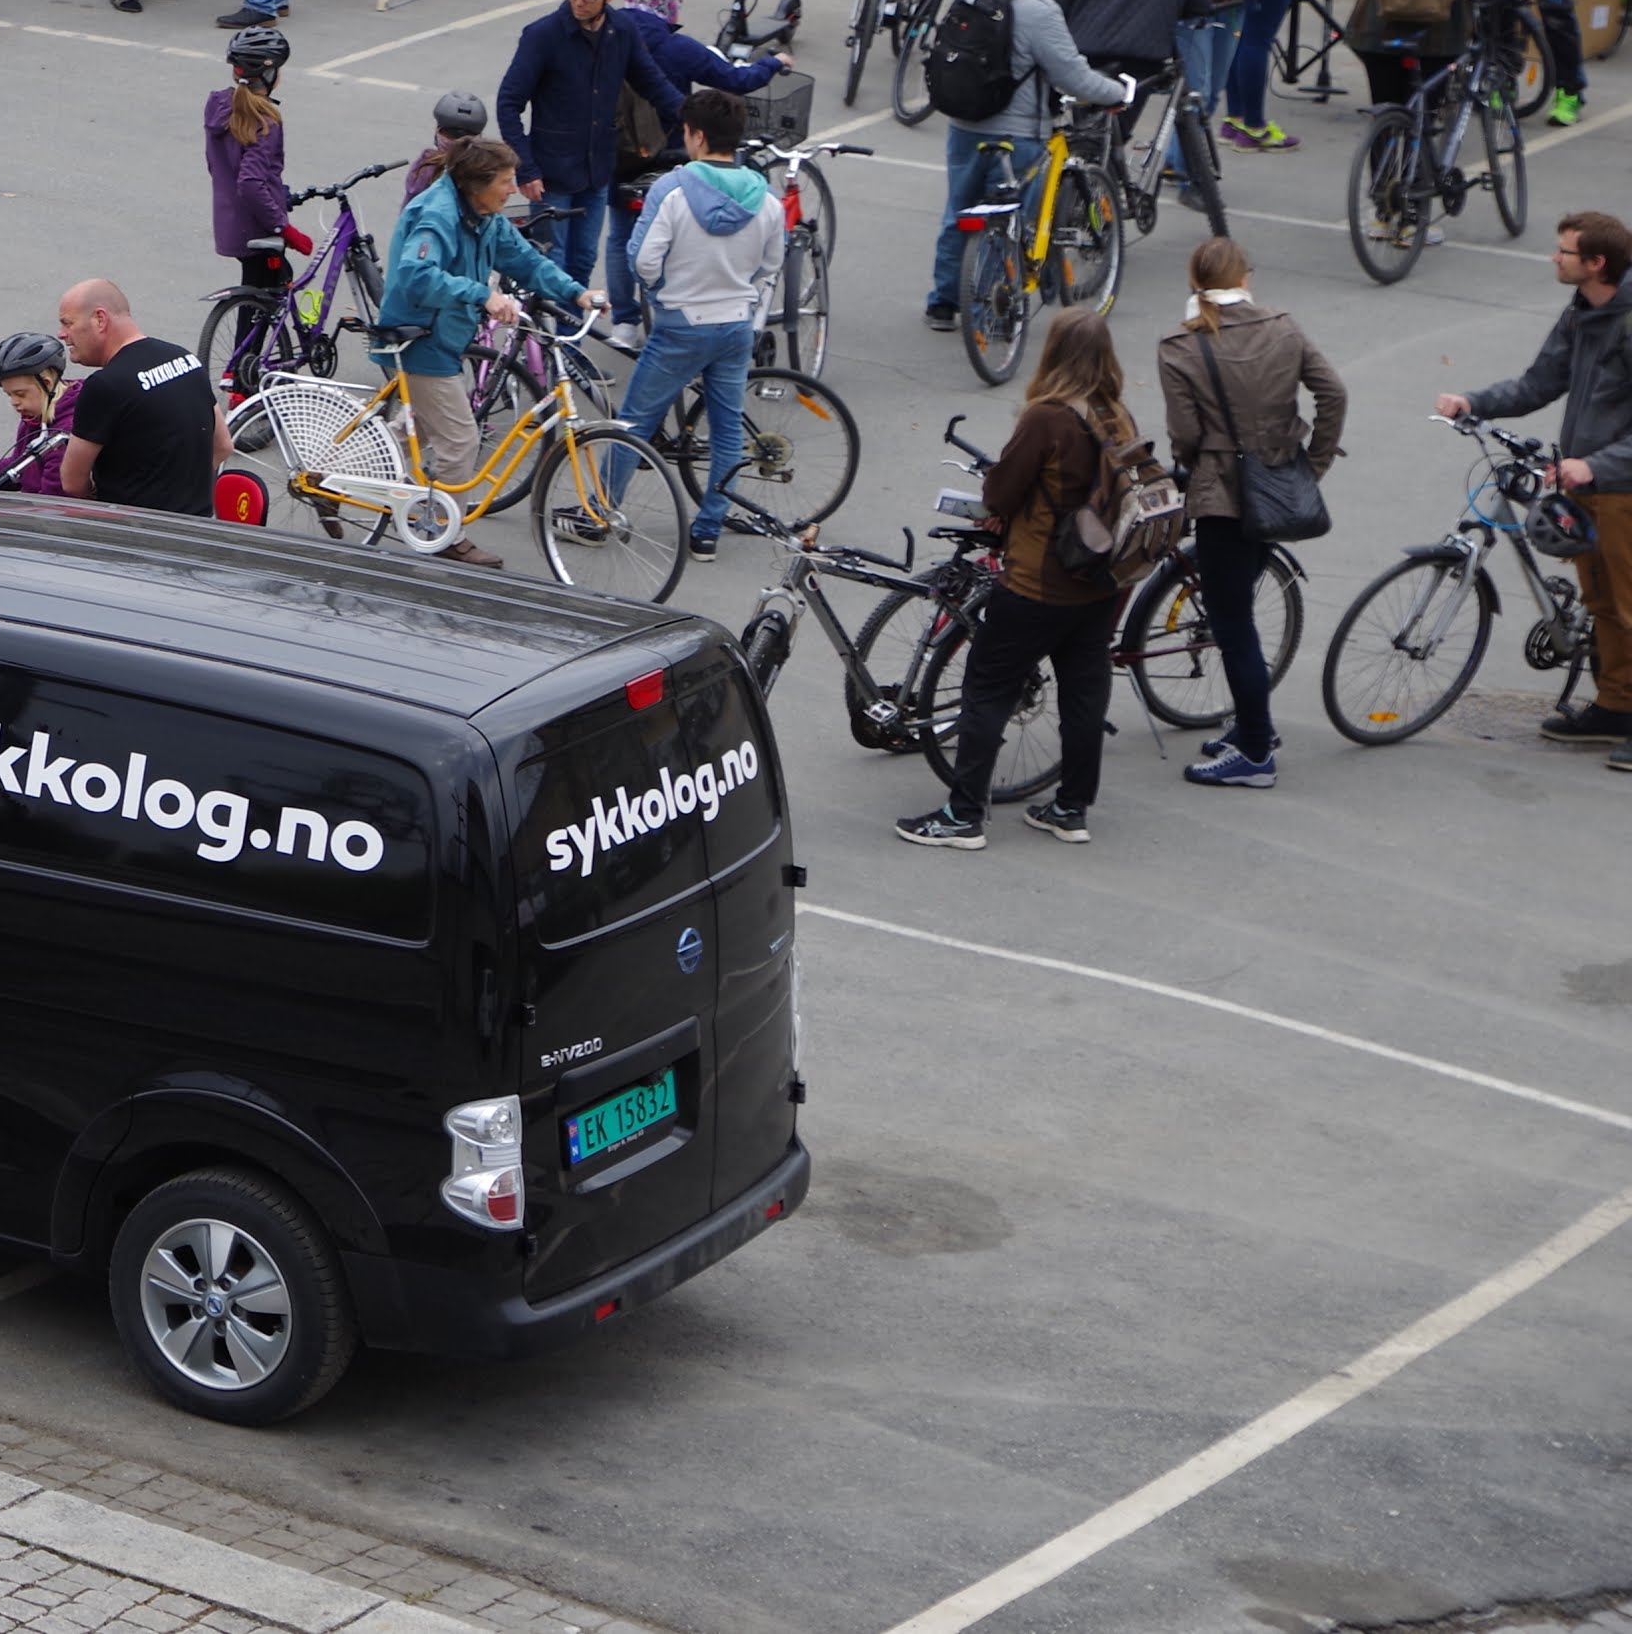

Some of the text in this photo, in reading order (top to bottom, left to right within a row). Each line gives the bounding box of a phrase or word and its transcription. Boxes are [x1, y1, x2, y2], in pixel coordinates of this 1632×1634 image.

[545, 740, 759, 878] sykkolog.no
[584, 1111, 608, 1151] EK
[614, 1080, 670, 1134] 15832
